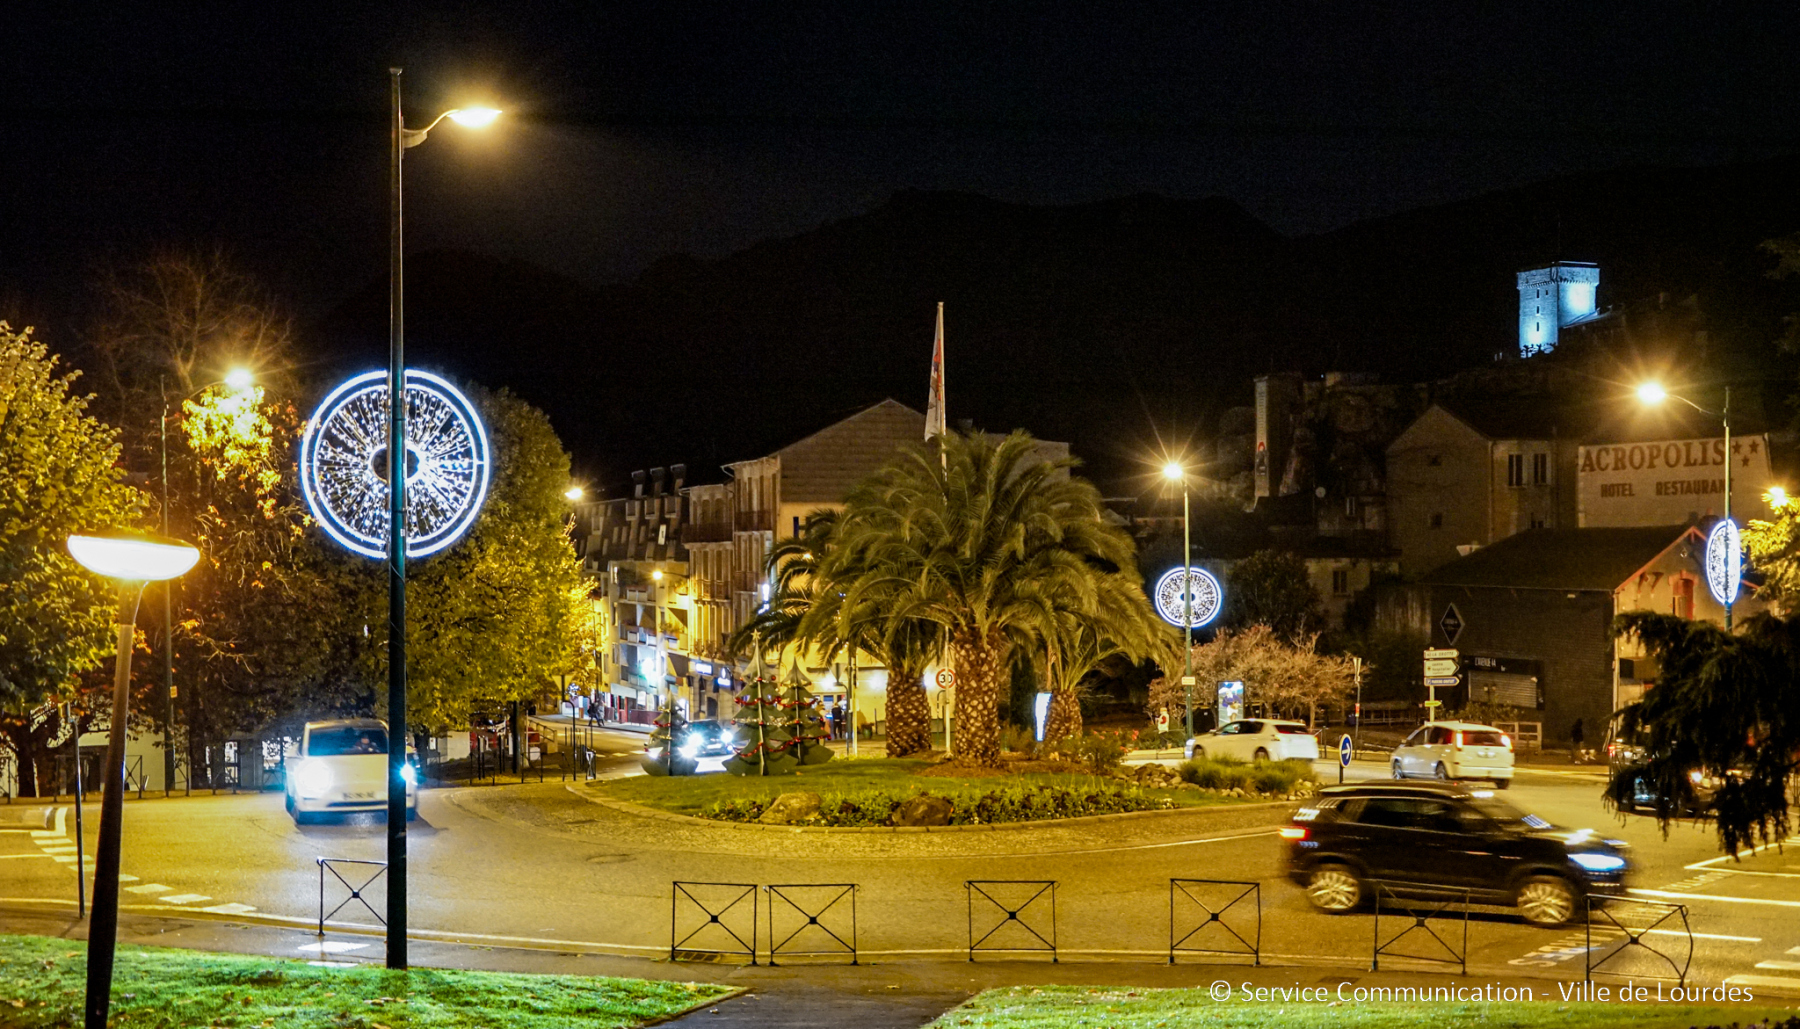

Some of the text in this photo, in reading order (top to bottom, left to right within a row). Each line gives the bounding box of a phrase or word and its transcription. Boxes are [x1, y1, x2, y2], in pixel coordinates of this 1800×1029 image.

[1580, 440, 1725, 472] ACROPOLIS
[1601, 483, 1635, 498] HOTEL
[940, 674, 953, 683] 30
